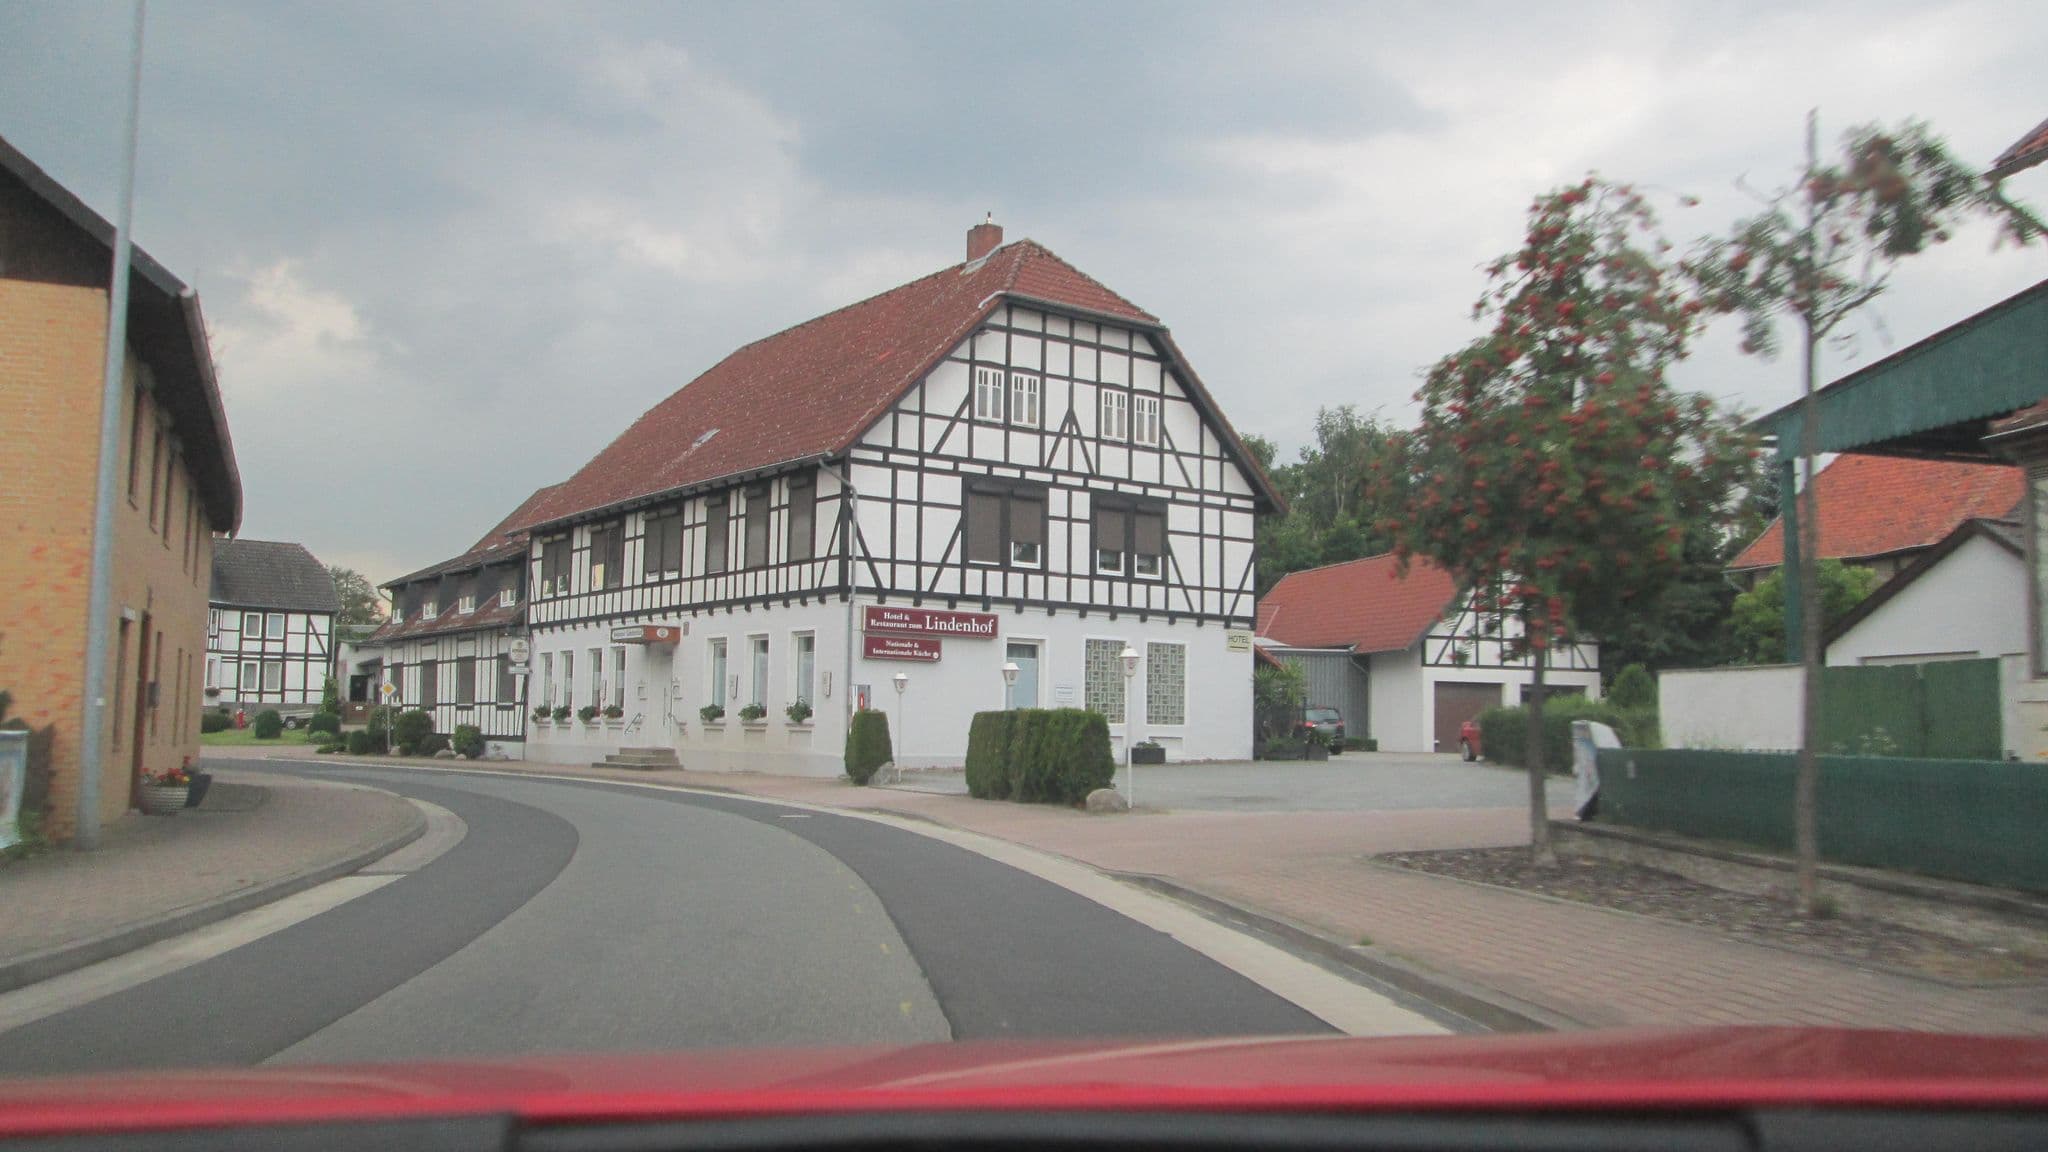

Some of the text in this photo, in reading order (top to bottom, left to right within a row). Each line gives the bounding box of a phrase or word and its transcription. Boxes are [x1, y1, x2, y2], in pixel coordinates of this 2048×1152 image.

[884, 612, 903, 620] Hotel
[871, 619, 907, 628] Restaurant
[925, 615, 994, 633] Lindenhof
[1228, 635, 1250, 644] HOTEL
